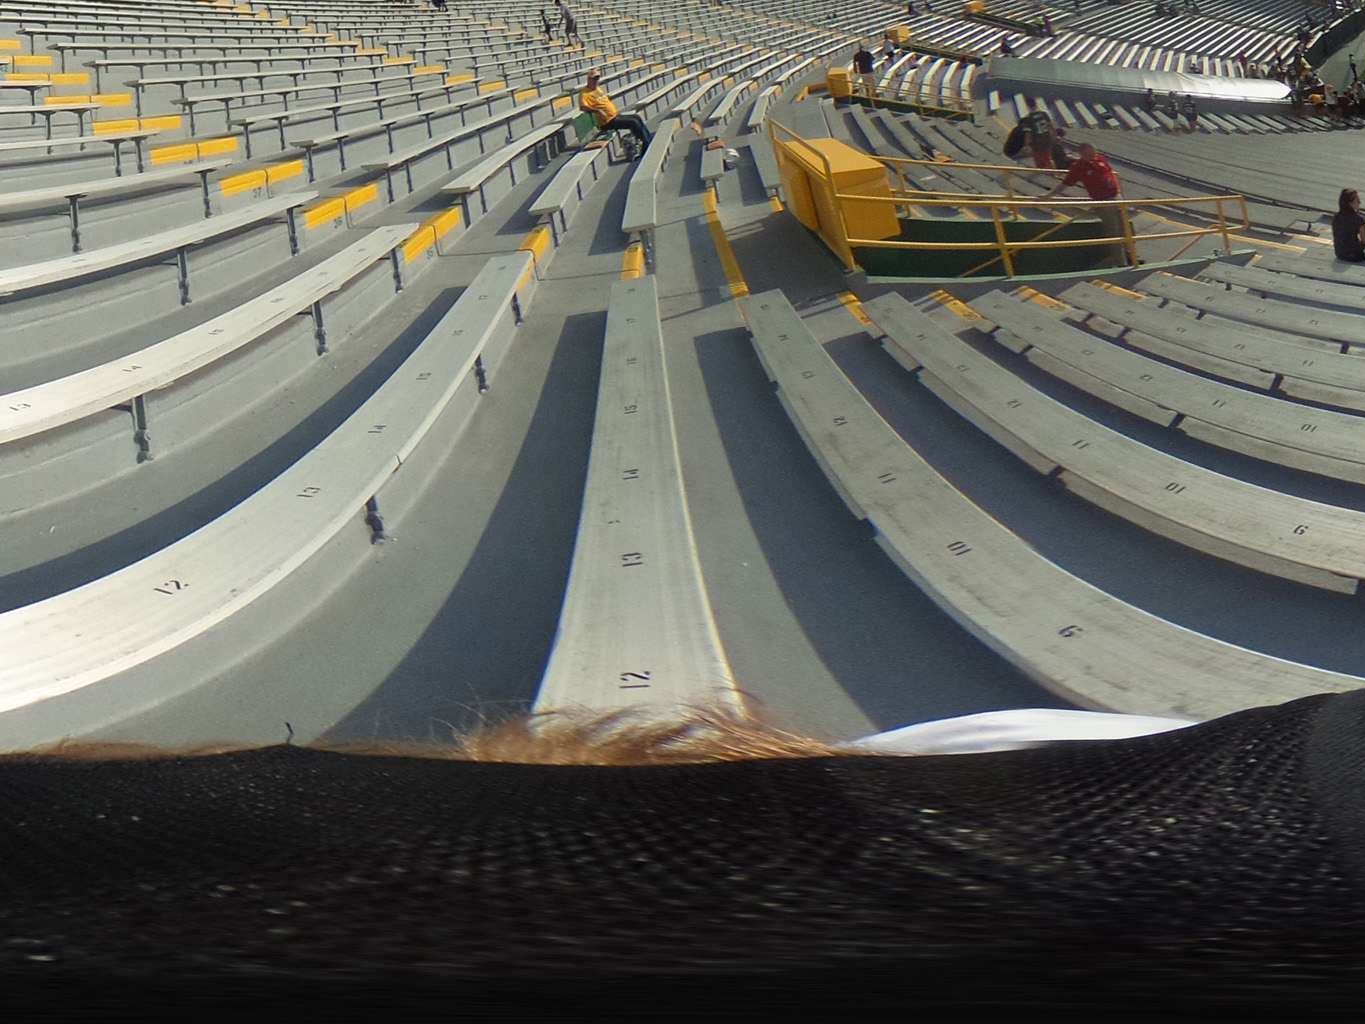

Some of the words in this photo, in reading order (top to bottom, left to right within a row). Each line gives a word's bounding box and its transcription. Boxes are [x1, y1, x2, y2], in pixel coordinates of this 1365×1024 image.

[9, 403, 31, 411] 13
[625, 405, 637, 414] 15
[834, 417, 847, 426] 12
[368, 425, 386, 433] 14
[1301, 424, 1317, 432] 10
[1072, 440, 1089, 449] 11
[623, 469, 639, 480] 14
[878, 473, 896, 483] 11
[297, 487, 321, 498] 13
[1164, 482, 1186, 494] 10
[1293, 524, 1309, 535] 9
[947, 541, 972, 556] 10
[622, 552, 643, 567] 13
[153, 580, 189, 595] 12
[1058, 625, 1083, 638] 9
[619, 671, 651, 689] 12
